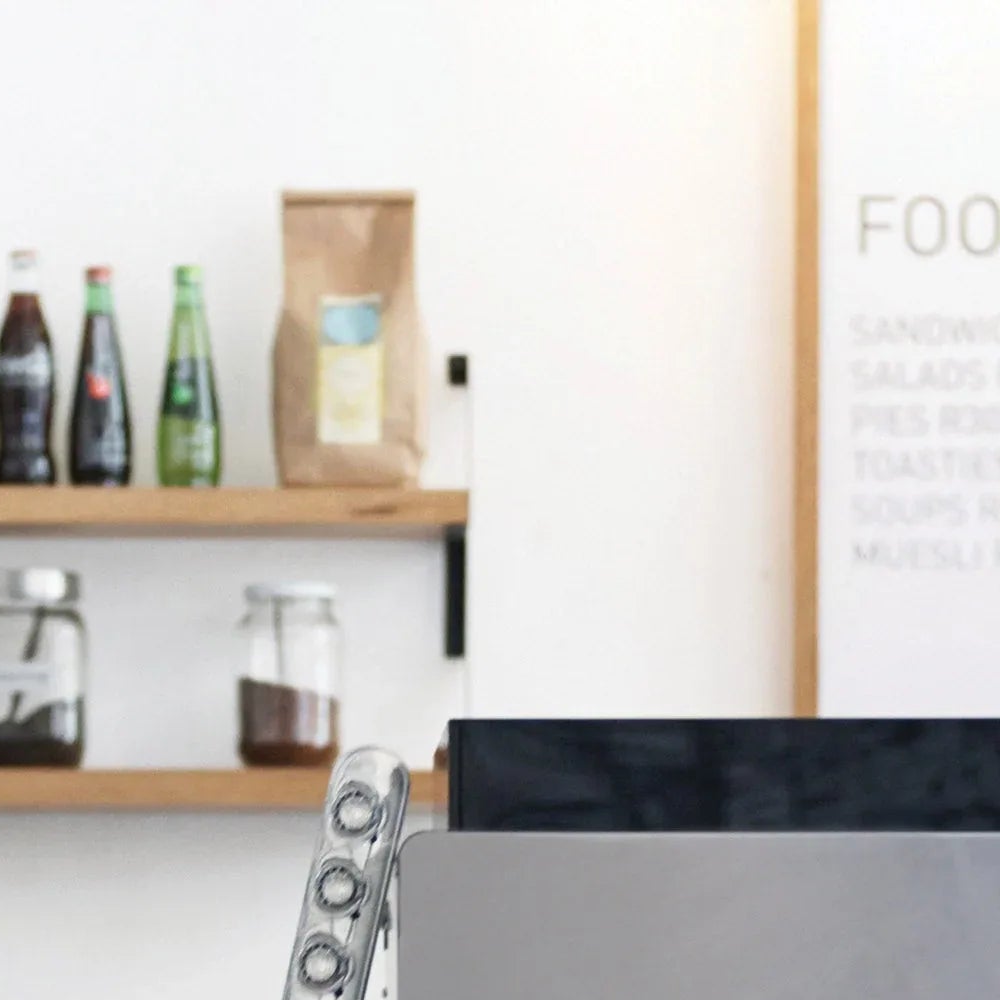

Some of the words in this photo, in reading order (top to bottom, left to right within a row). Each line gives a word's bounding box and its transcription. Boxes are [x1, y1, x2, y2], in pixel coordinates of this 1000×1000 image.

[857, 194, 1000, 257] FOO
[848, 358, 987, 392] SALADS
[850, 492, 969, 527] SOUPS
